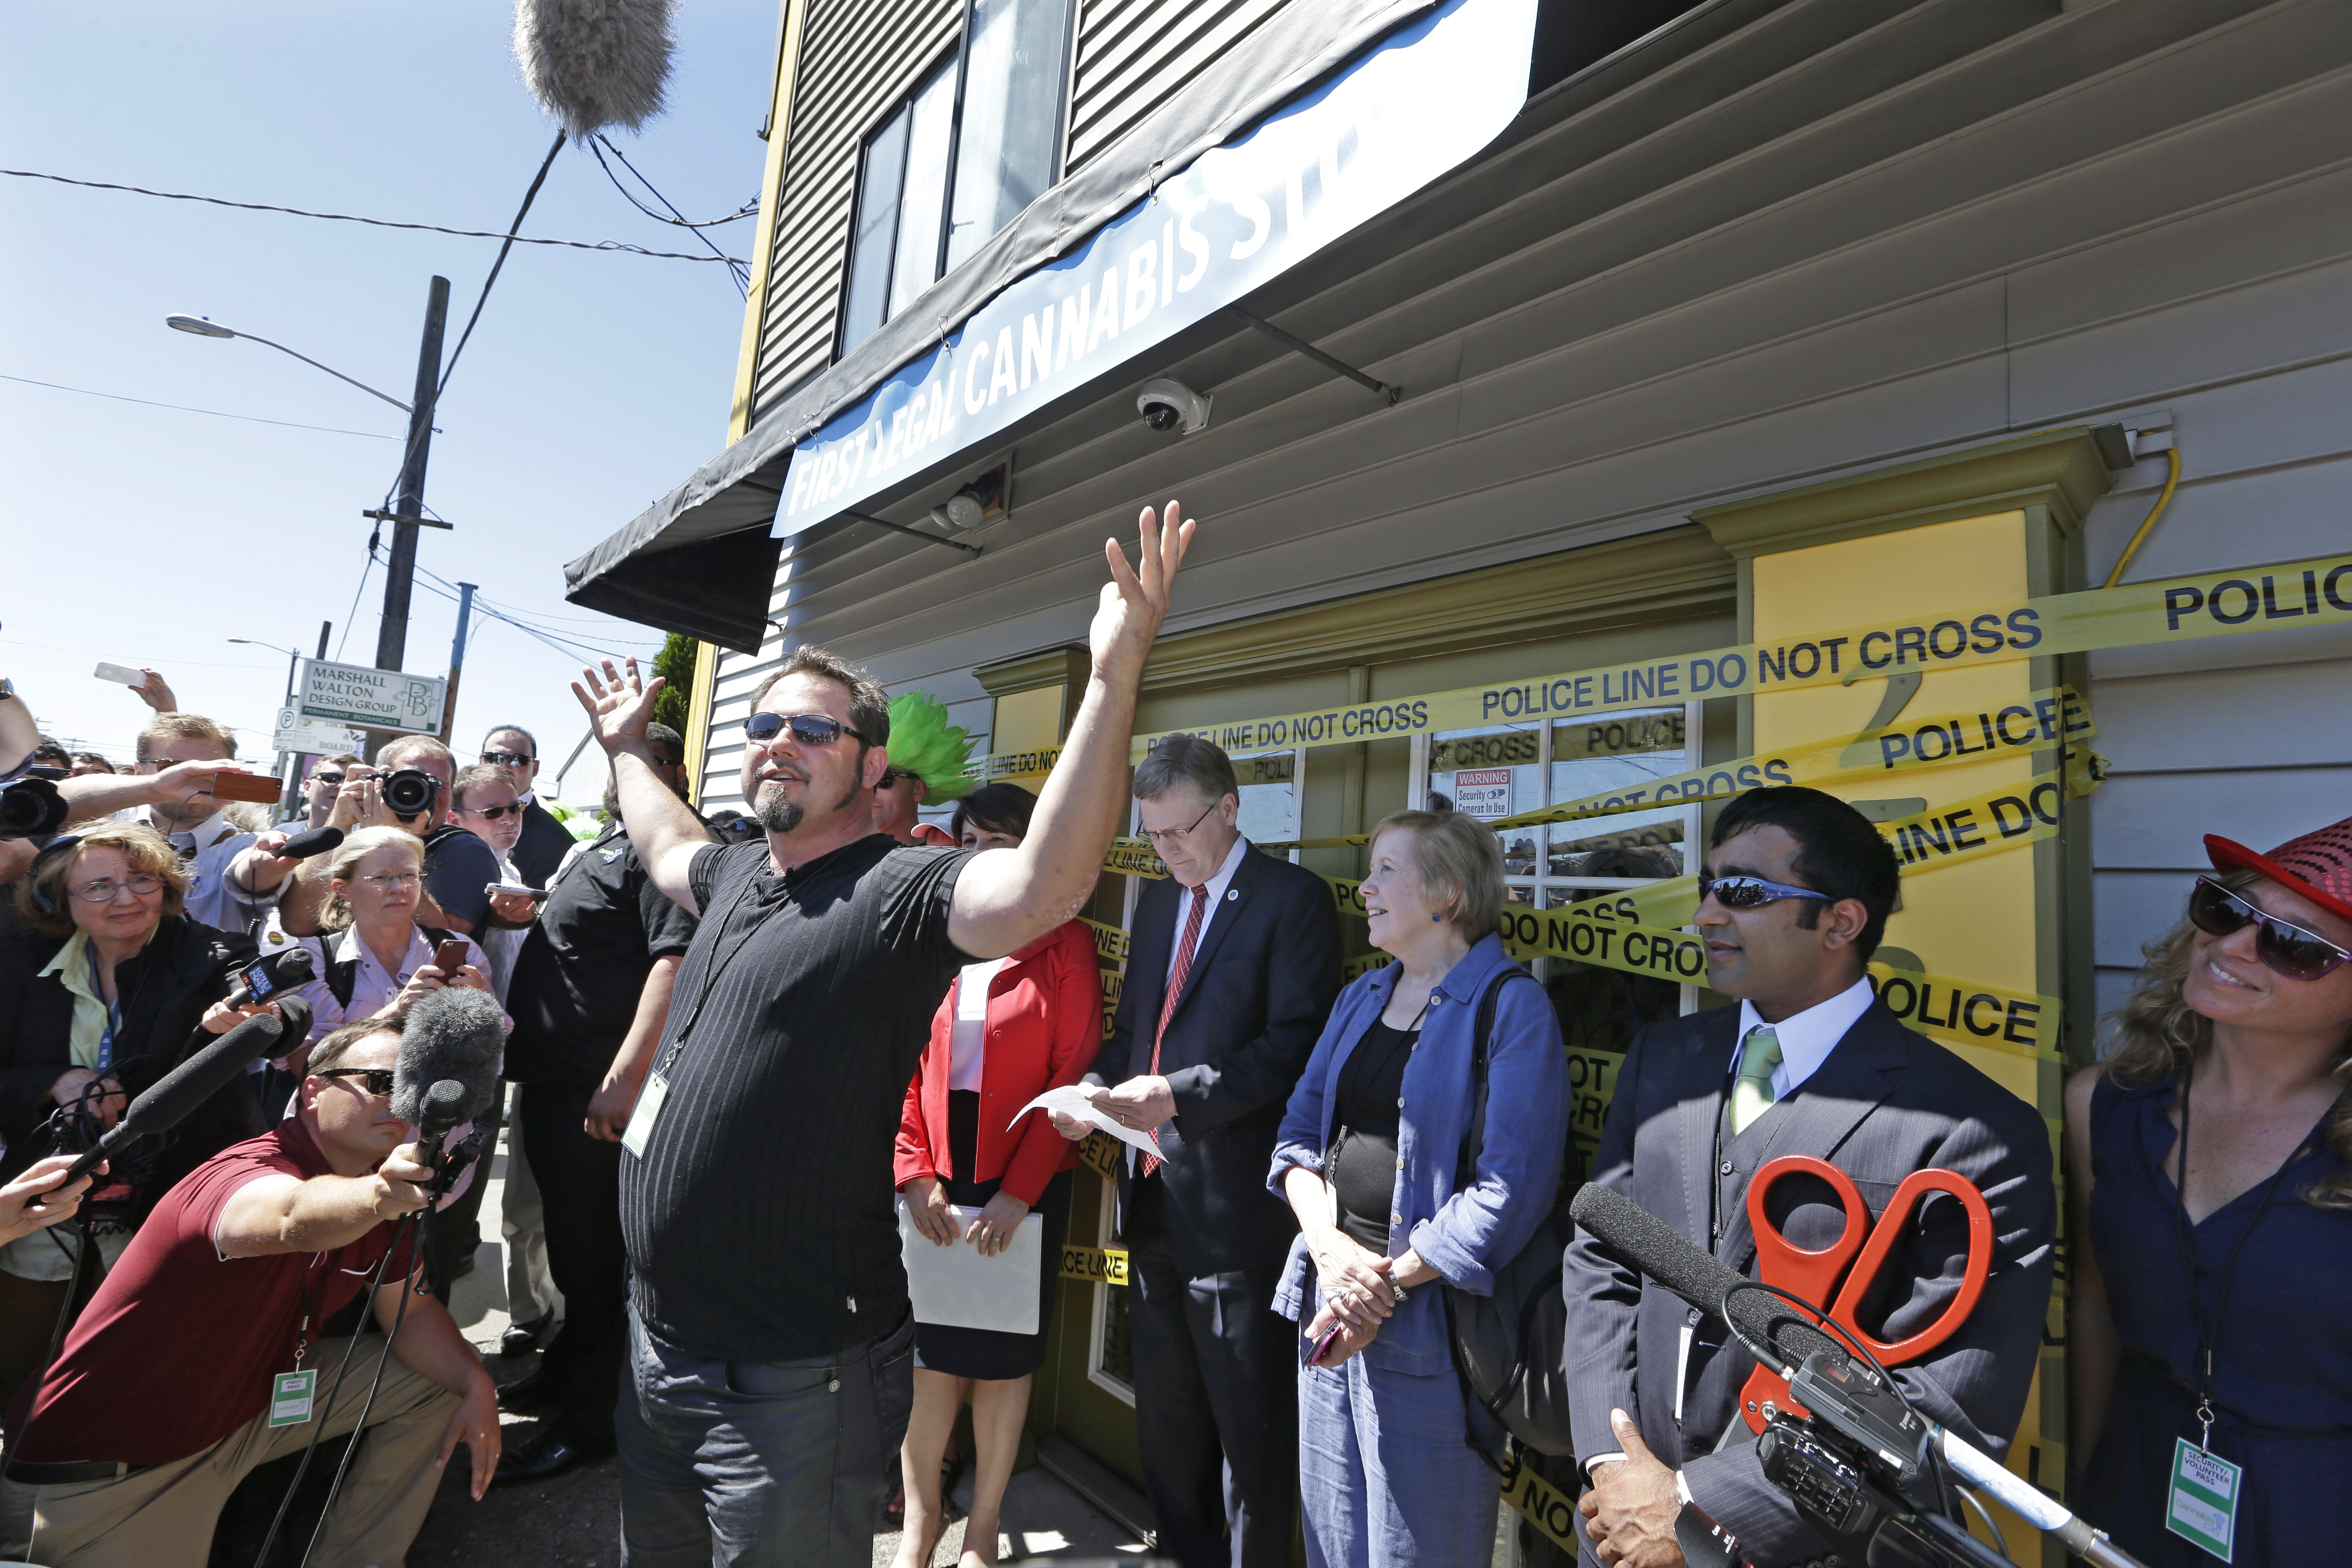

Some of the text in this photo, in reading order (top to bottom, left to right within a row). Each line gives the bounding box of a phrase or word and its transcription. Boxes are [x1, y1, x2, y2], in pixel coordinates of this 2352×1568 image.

[787, 429, 869, 515] FIRST
[867, 368, 956, 479] LEGAL
[964, 192, 1210, 415] CANNABIS
[1483, 608, 2043, 720] POLICE LINE DO NOT CROSS
[313, 667, 386, 687] MARSHALL
[312, 680, 374, 699] WALTON
[309, 693, 397, 713] DESIGN GROUP
[284, 715, 291, 725] P
[304, 707, 398, 725] PERMANENT BOTANICALS
[1258, 720, 1287, 747] DO
[1293, 714, 1338, 743] NOT
[1342, 700, 1428, 737] CROSS
[319, 741, 353, 752] BOARD
[991, 755, 1016, 775] LINE
[1019, 753, 1037, 772] DO
[1039, 750, 1062, 770] NO
[1460, 772, 1508, 784] WARNING
[1459, 790, 1485, 802] Security
[1459, 803, 1505, 813] Cameras In Use
[1898, 808, 1987, 866] INE
[1113, 851, 1151, 874] LINE
[1548, 919, 1617, 960] NOT
[1624, 932, 1708, 978] CRO
[1088, 1253, 1123, 1279] LINE
[2185, 1457, 2230, 1485] VOLUNTEER
[2188, 1451, 2228, 1475] SECURITY/
[2196, 1471, 2215, 1485] PASS
[1799, 1494, 1813, 1504] AUDIO
